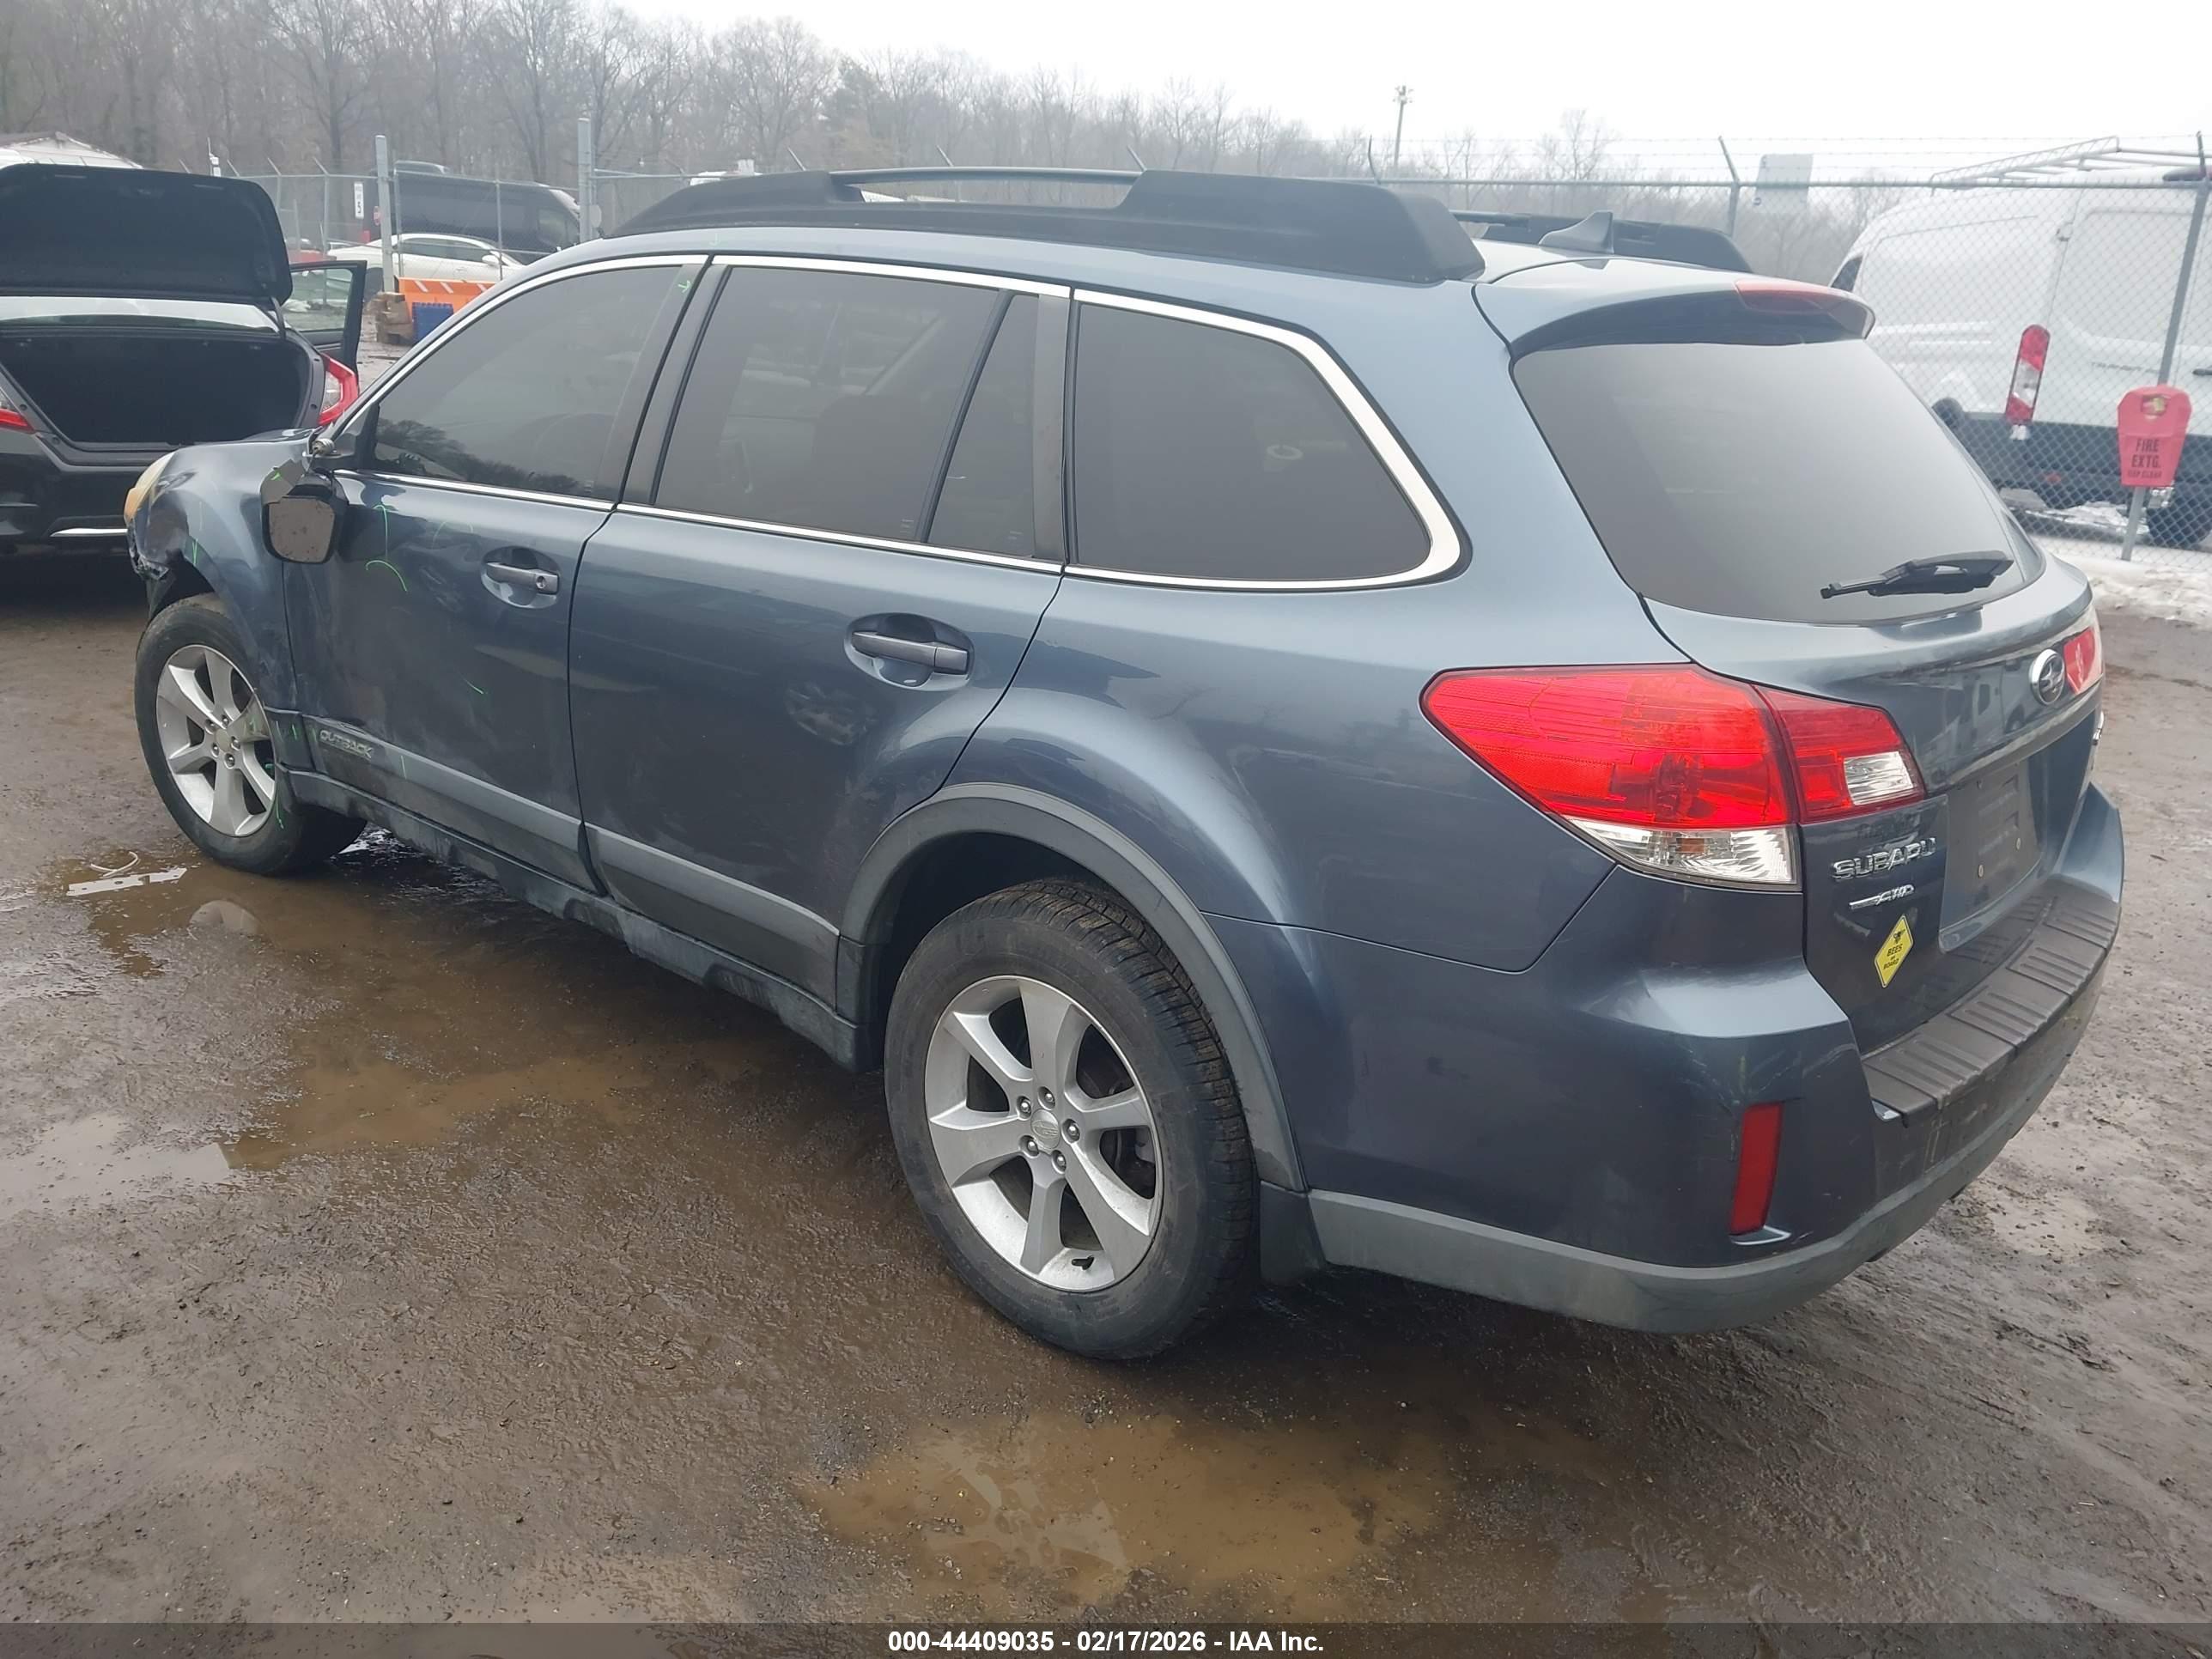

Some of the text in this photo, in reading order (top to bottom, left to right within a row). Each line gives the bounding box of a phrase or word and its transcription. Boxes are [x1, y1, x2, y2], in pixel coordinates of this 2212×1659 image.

[2136, 438, 2160, 453] FIRE
[319, 730, 373, 759] OUTBACK
[1832, 837, 1936, 878] SUBARU
[1887, 943, 1903, 957] BEES
